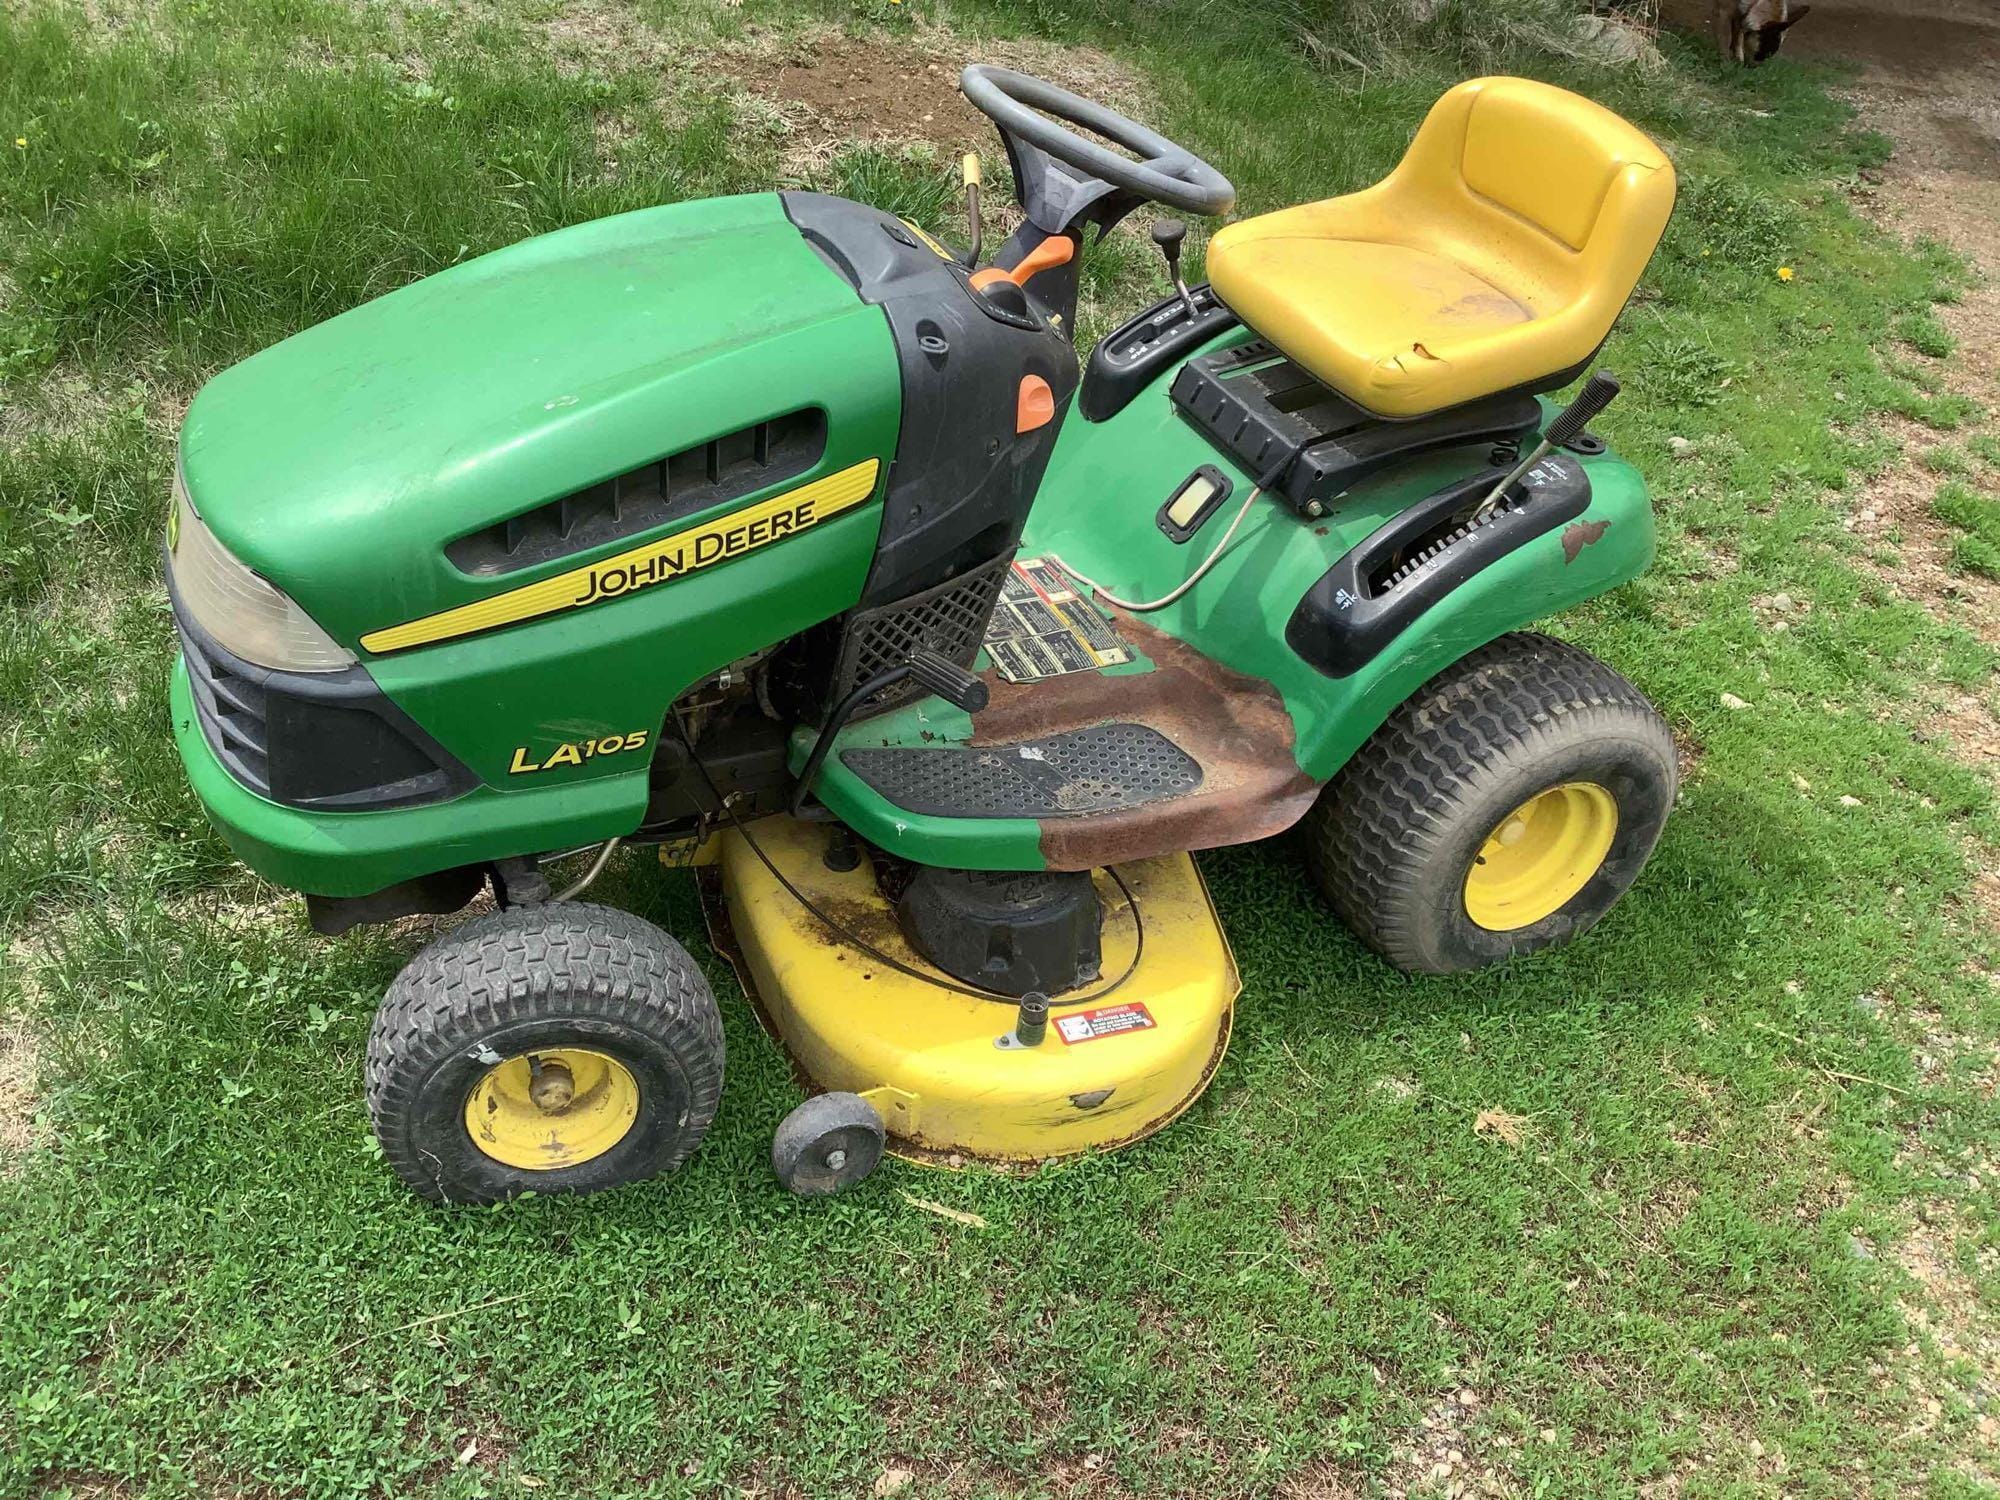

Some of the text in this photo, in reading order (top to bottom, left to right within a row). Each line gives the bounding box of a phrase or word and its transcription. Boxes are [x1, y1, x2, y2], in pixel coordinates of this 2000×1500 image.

[575, 500, 816, 604] JOHN DEERE
[509, 730, 648, 774] LA105
